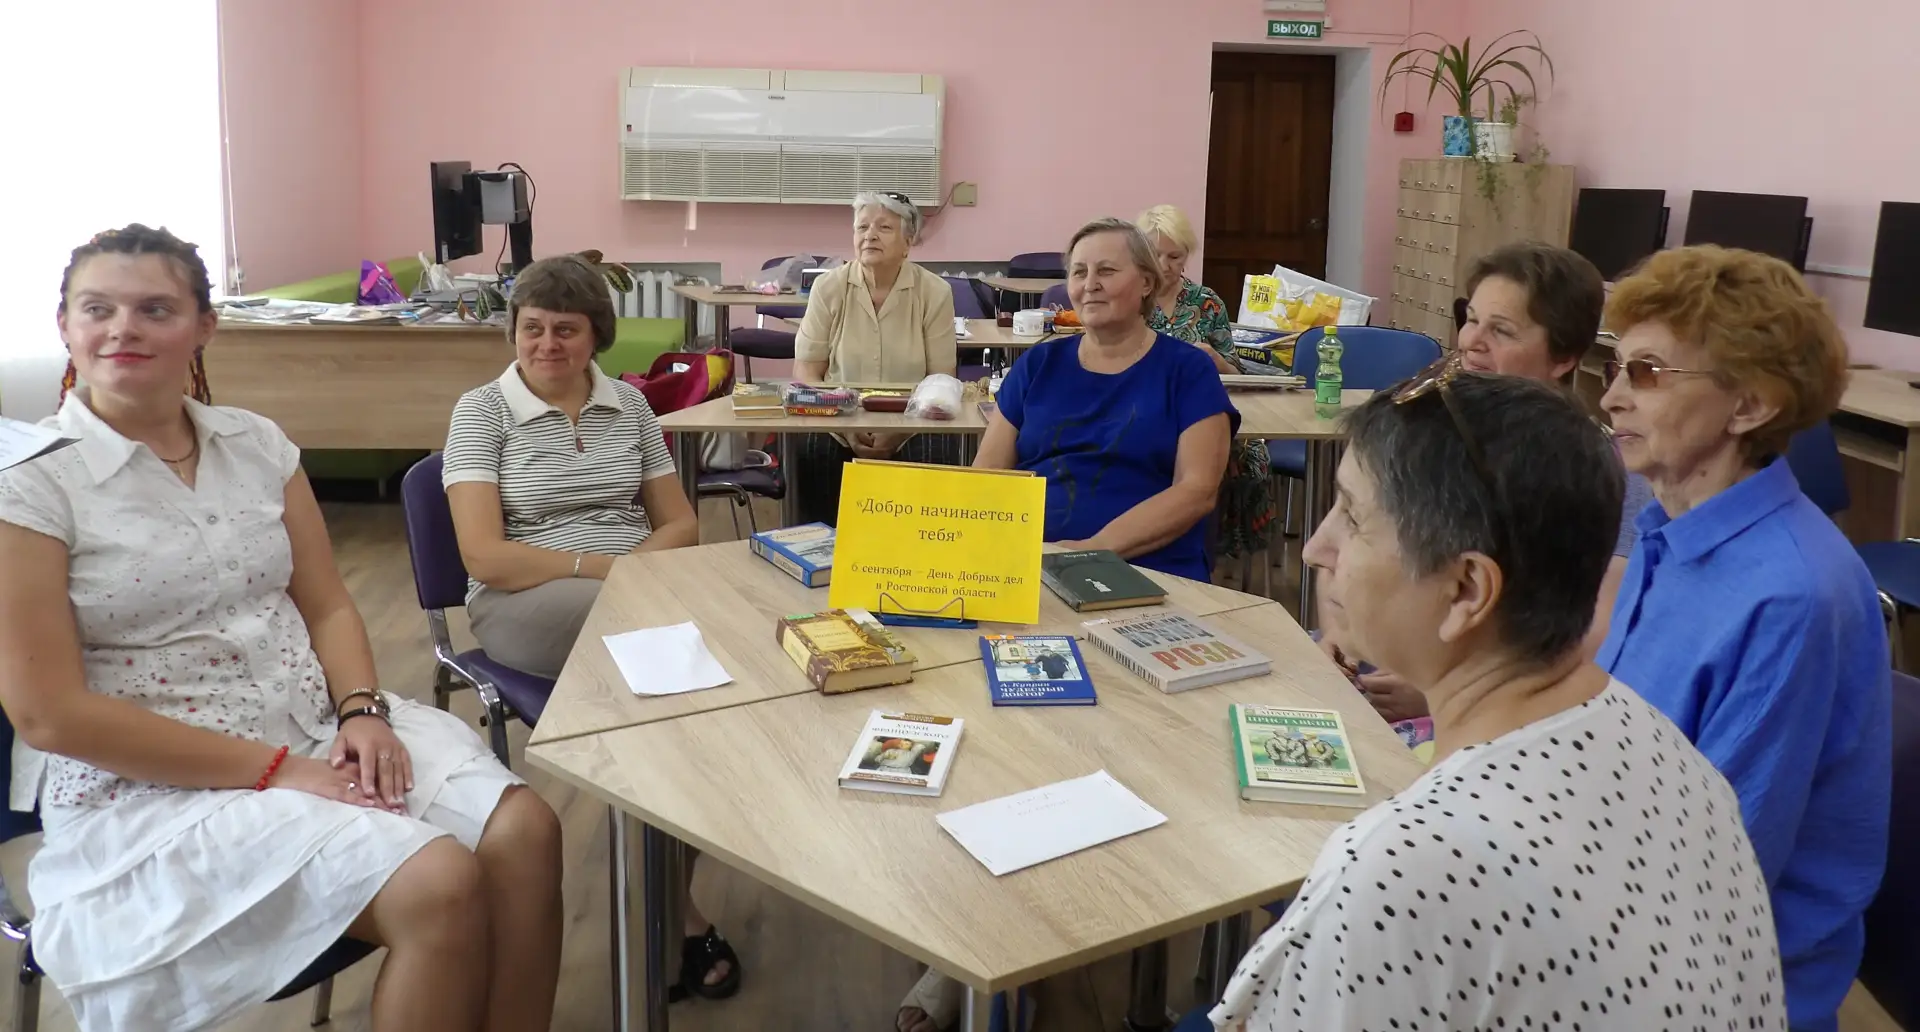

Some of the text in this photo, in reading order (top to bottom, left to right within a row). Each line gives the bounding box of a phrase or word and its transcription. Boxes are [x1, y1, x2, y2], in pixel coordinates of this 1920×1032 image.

[1272, 22, 1317, 36] ВЫХОД
[856, 498, 1029, 523] «Добро начинается с
[918, 528, 963, 542] тебя»
[851, 562, 858, 572] 6
[862, 565, 912, 578] сентября
[926, 568, 954, 580] День
[958, 570, 1000, 584] Добрых
[1003, 575, 1023, 585] дел
[886, 580, 948, 595] Ростовской
[952, 586, 996, 598] области
[1150, 640, 1247, 671] РОЗА
[897, 723, 930, 731] УРОКИ
